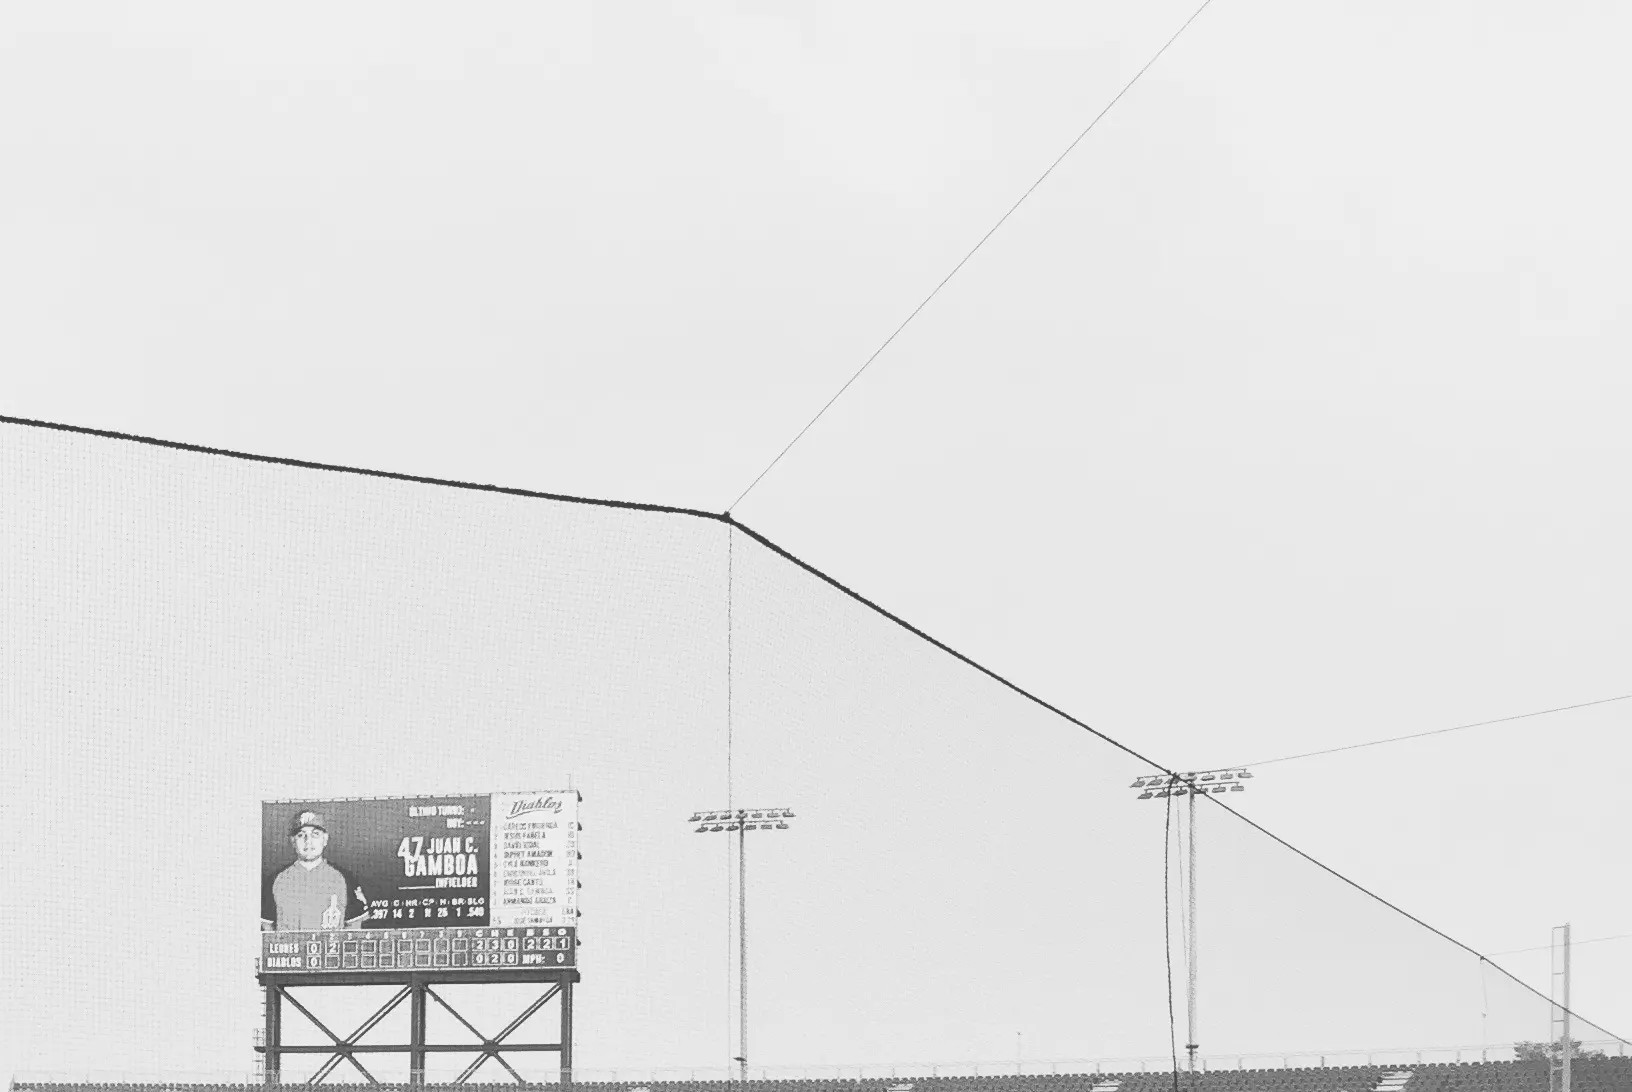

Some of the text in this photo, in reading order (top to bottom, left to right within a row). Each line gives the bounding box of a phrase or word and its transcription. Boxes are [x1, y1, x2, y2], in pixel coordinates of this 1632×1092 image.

[398, 836, 478, 863] 47 JUAN C.
[405, 854, 478, 877] GAMBOA
[409, 908, 415, 918] 2
[456, 907, 461, 917] 1
[311, 943, 318, 953] 0
[329, 942, 336, 953] 2
[477, 939, 514, 949] 2 3 0
[527, 938, 566, 948] 2 2 1
[268, 957, 317, 967] DIABLOS 0
[476, 953, 514, 963] 0 2 0
[557, 952, 564, 963] 0
